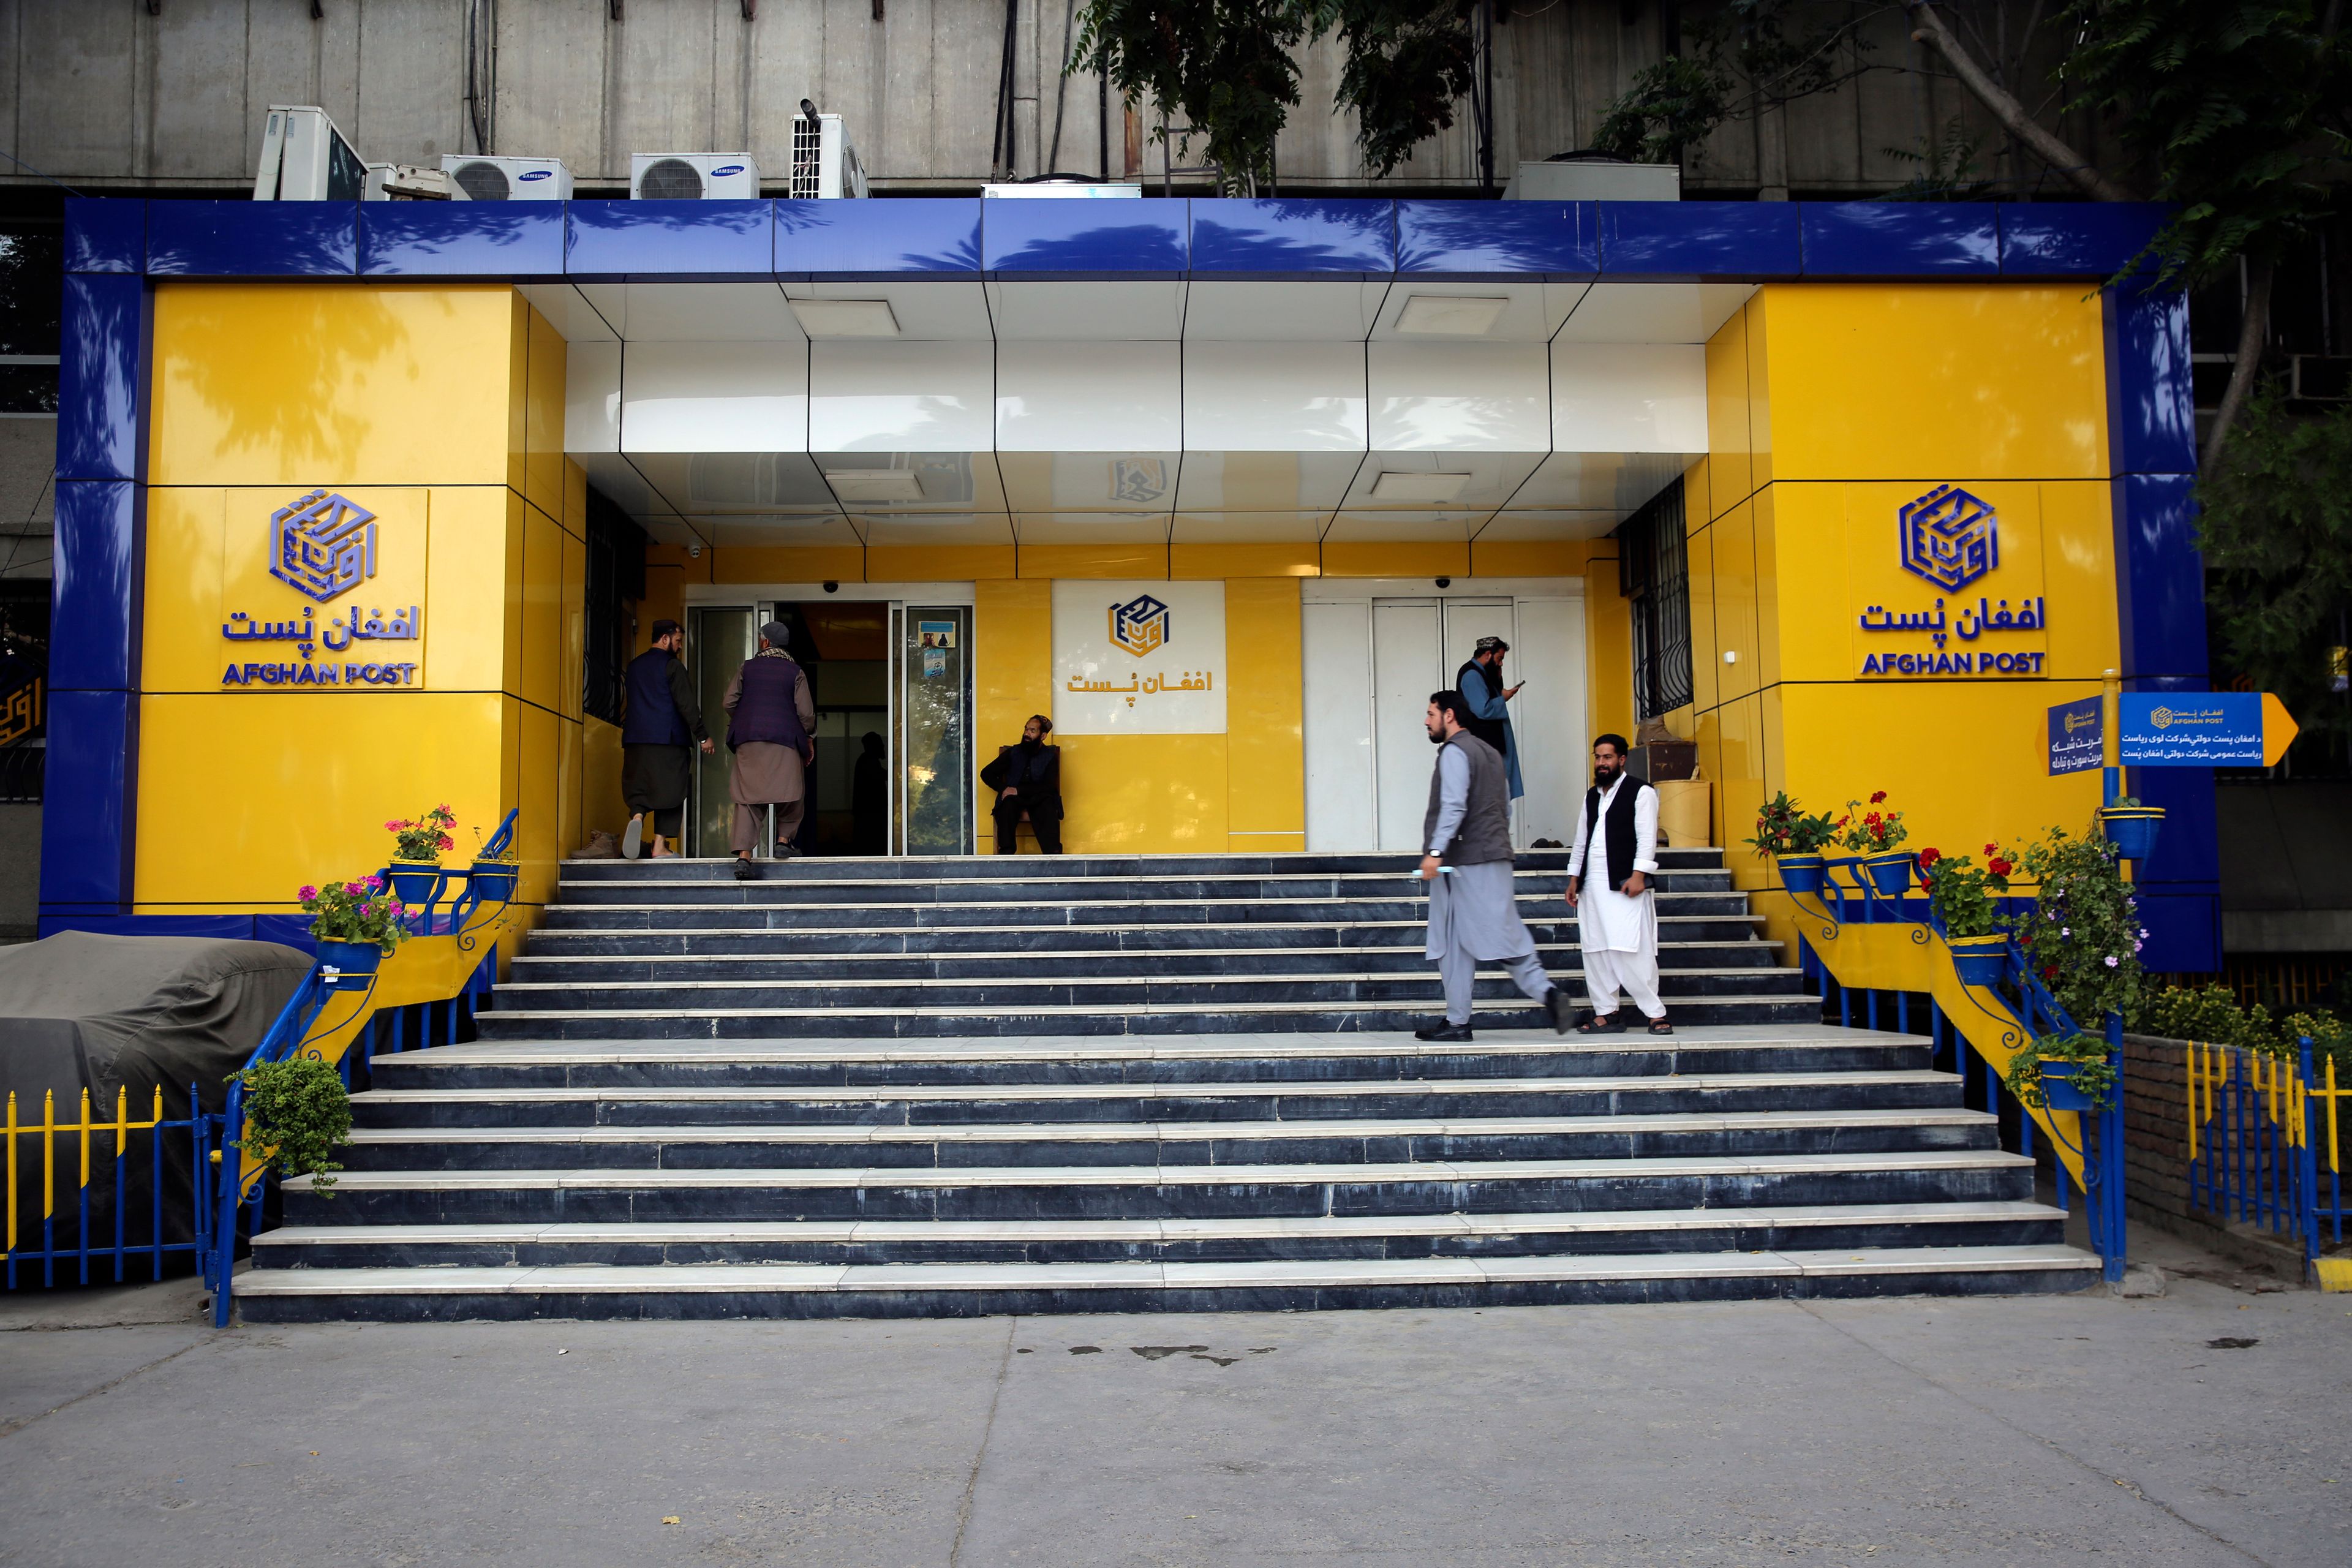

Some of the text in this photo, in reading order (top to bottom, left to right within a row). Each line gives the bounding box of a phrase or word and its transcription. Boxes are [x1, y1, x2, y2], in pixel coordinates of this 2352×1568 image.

[323, 606, 418, 650] افغان
[1954, 597, 2045, 640] افغان
[222, 663, 417, 684] AFGHAN POST
[1861, 652, 2045, 674] AFGHAN POST
[1142, 671, 1212, 694] افغان
